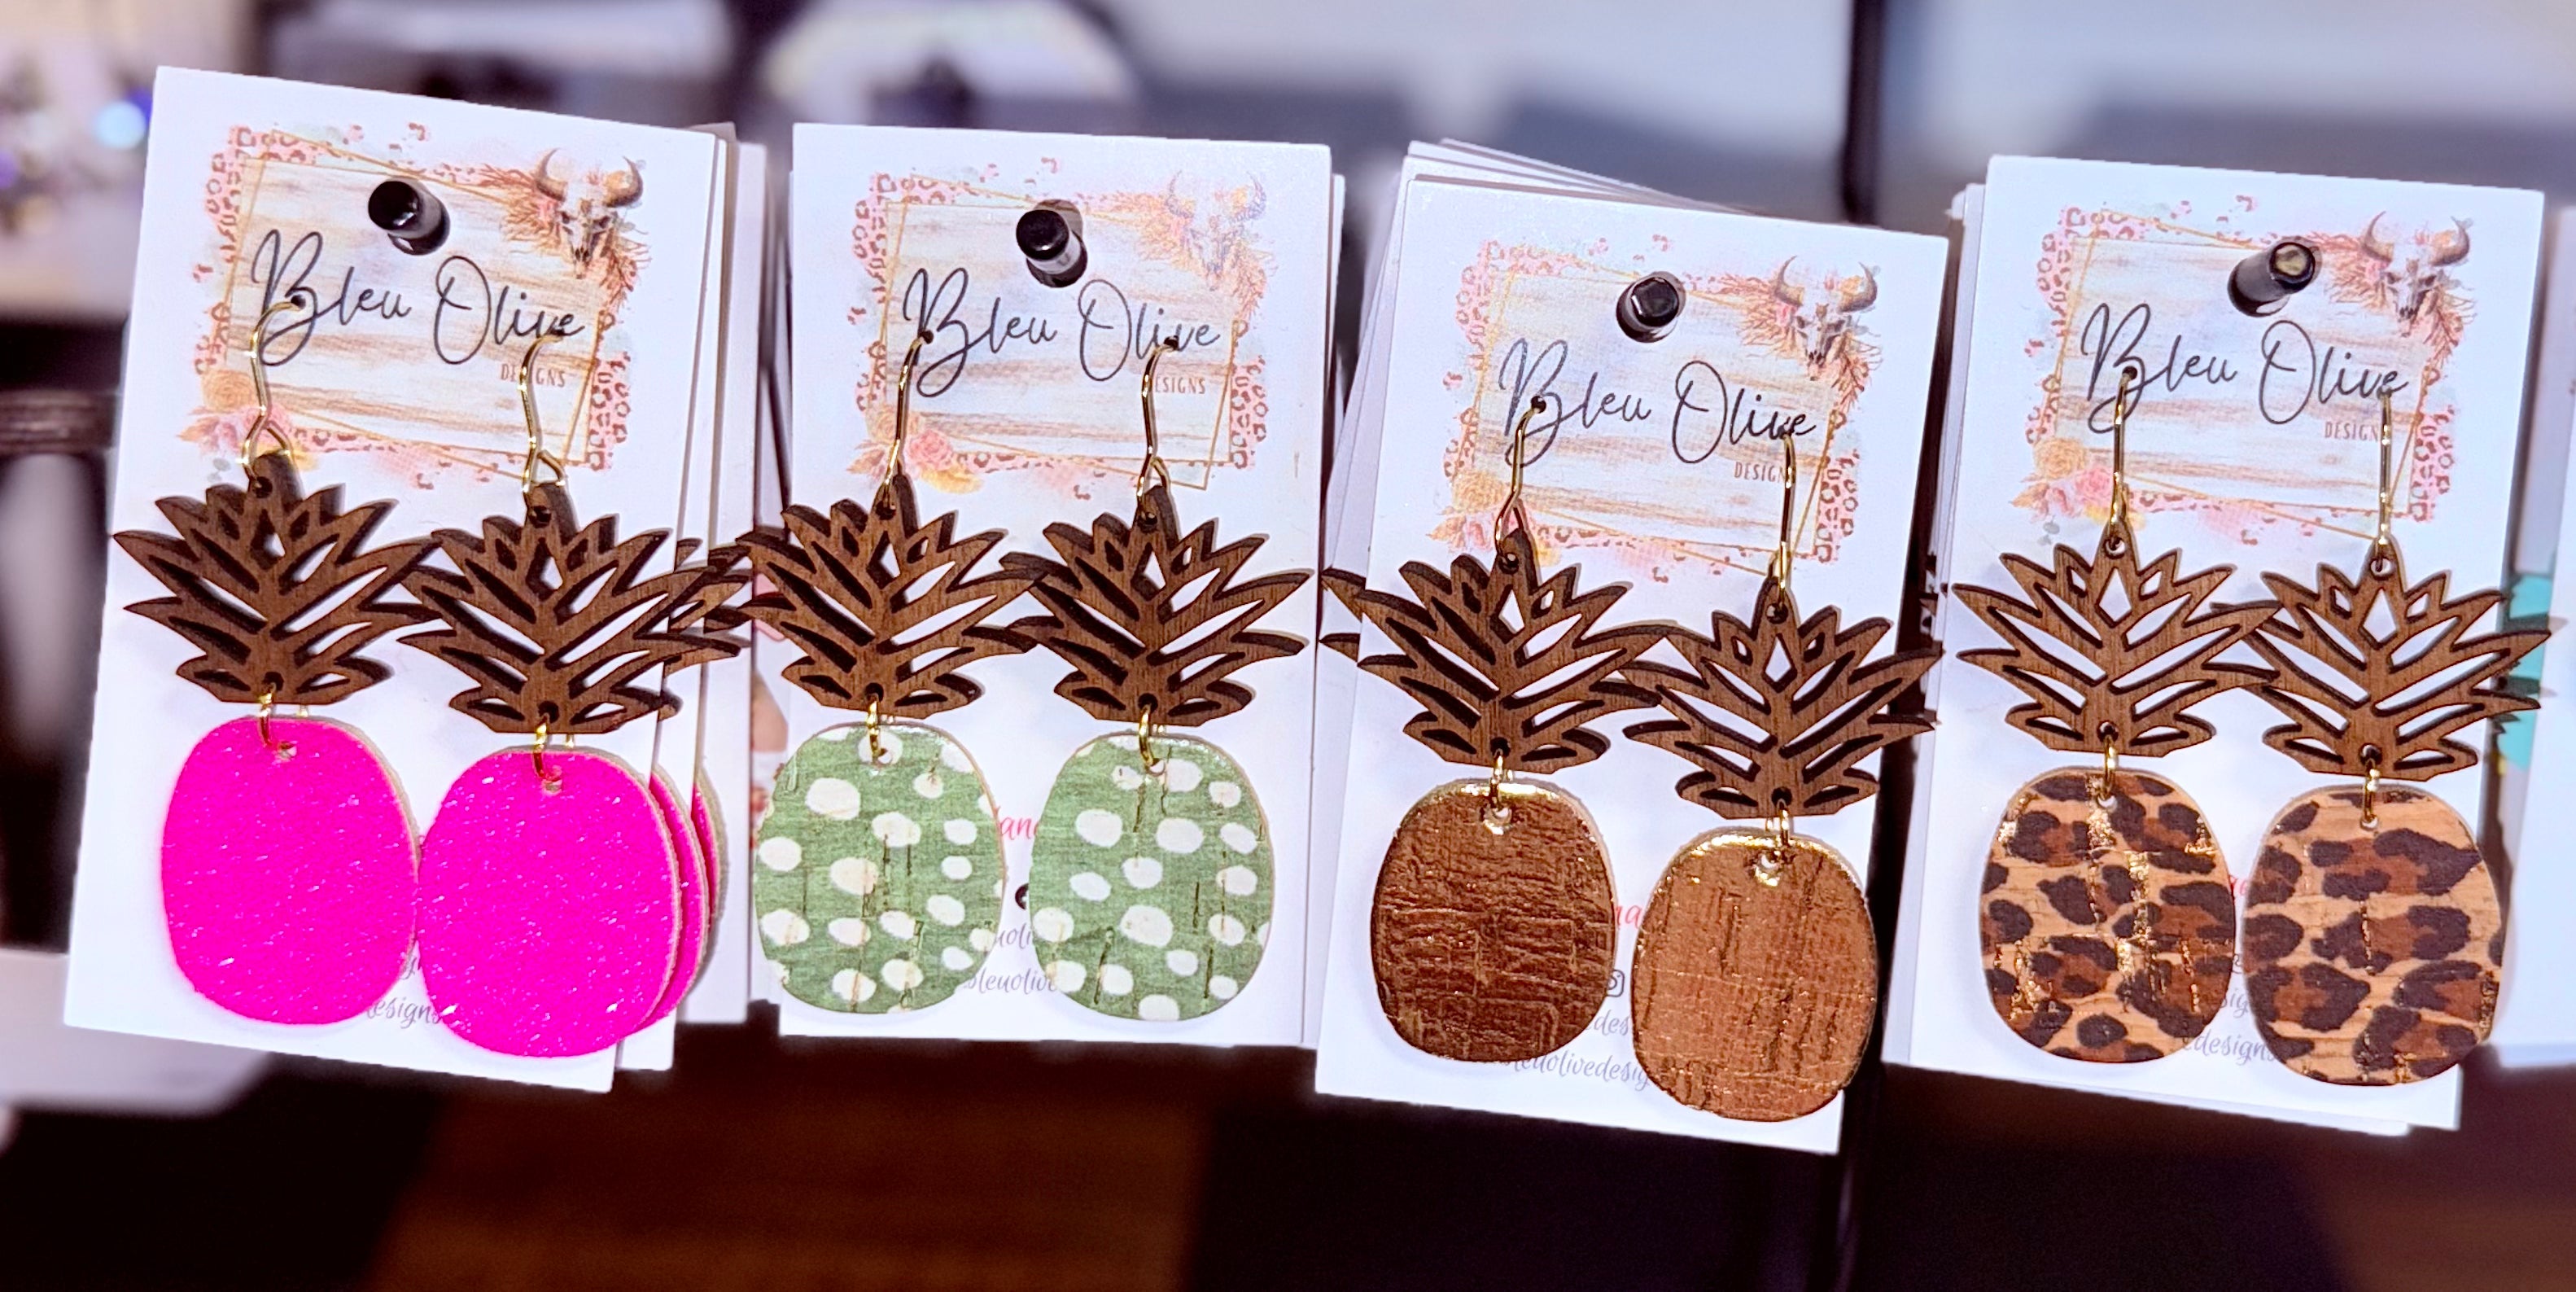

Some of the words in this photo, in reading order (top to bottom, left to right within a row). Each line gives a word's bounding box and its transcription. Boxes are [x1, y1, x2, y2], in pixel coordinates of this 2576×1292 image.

[251, 229, 411, 366] Bleu
[433, 255, 585, 365] Olive
[903, 268, 1057, 396] Bleu
[1078, 278, 1220, 381] Olive
[501, 363, 566, 388] DEGNS
[1154, 376, 1206, 395] ESIGNS
[1498, 337, 1651, 467] Bleu
[1672, 360, 1817, 464] Olive
[2080, 302, 2237, 433] Bleu
[2259, 319, 2408, 424] Olive
[2324, 421, 2380, 443] DESIGN
[1734, 461, 1787, 483] DESIGN
